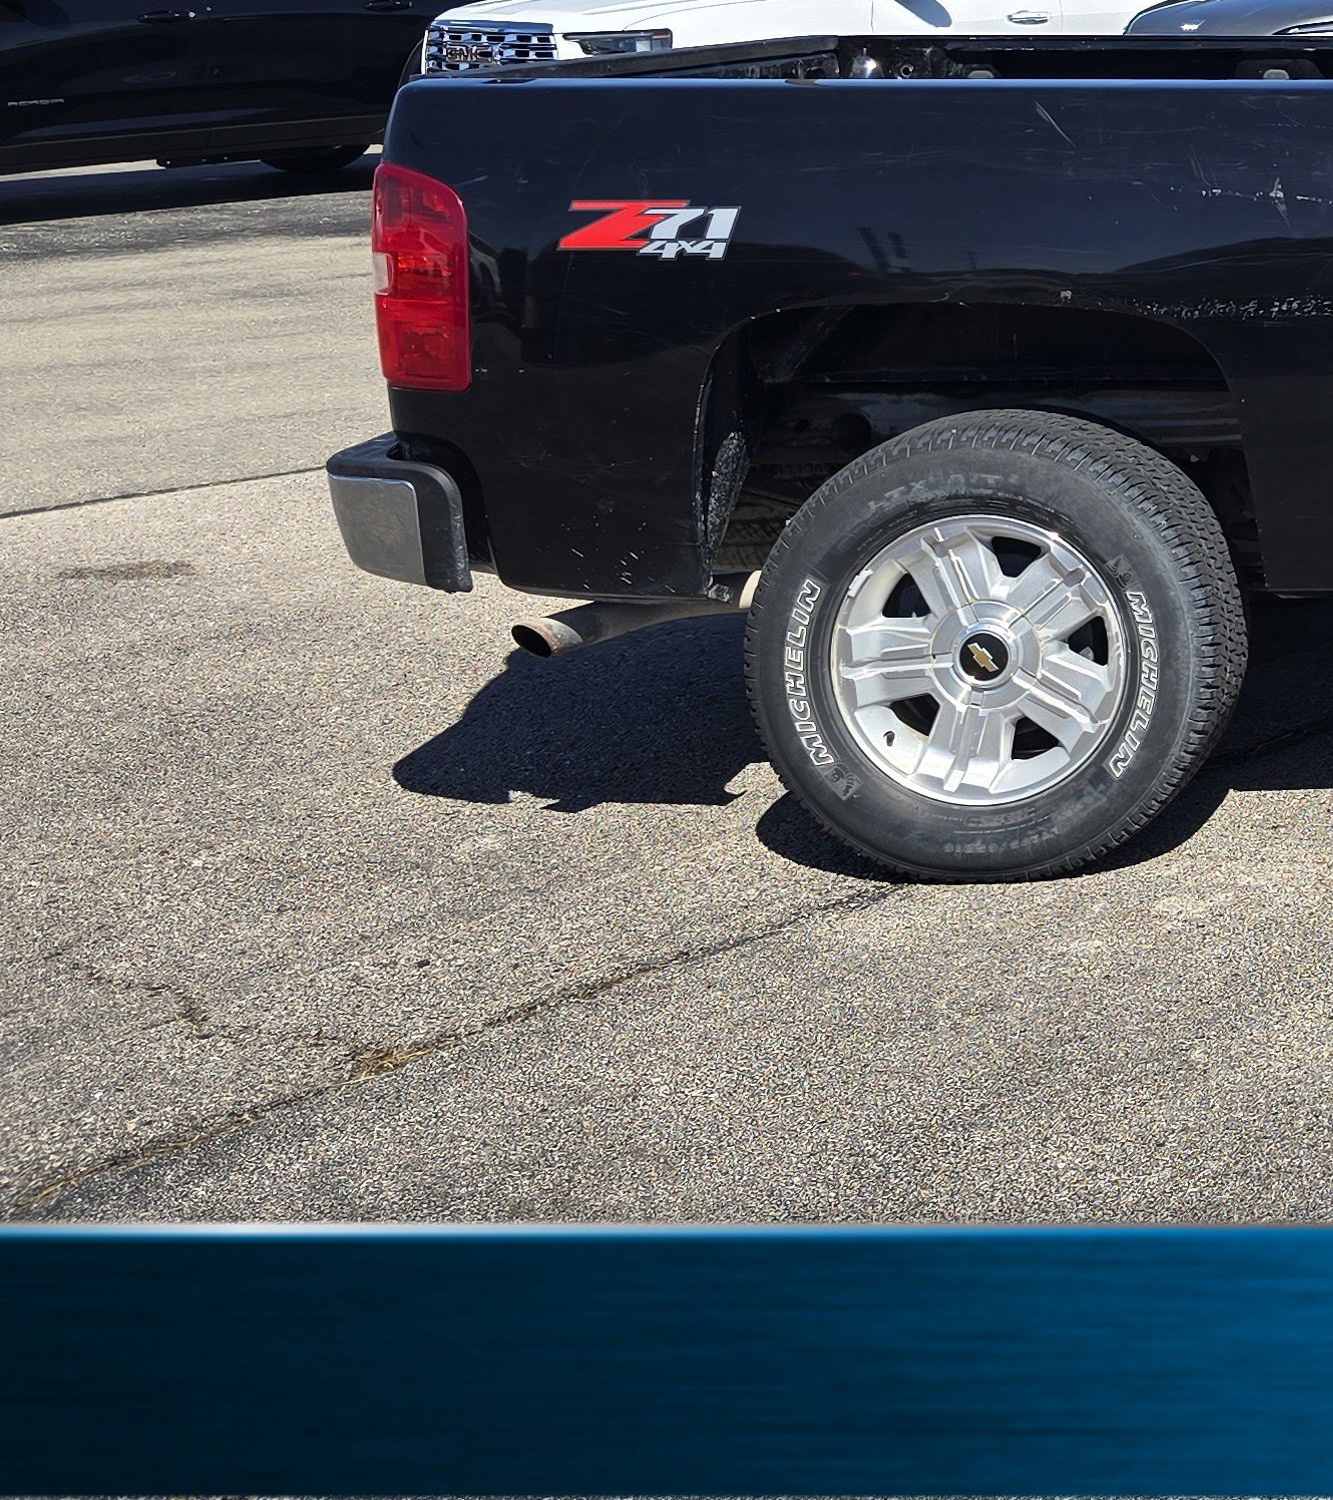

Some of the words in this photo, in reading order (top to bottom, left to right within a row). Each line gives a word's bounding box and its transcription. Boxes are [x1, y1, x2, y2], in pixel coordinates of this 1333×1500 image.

[557, 200, 741, 250] Z71
[784, 579, 835, 767] MICHELIN
[1108, 591, 1160, 779] MICHELIN
